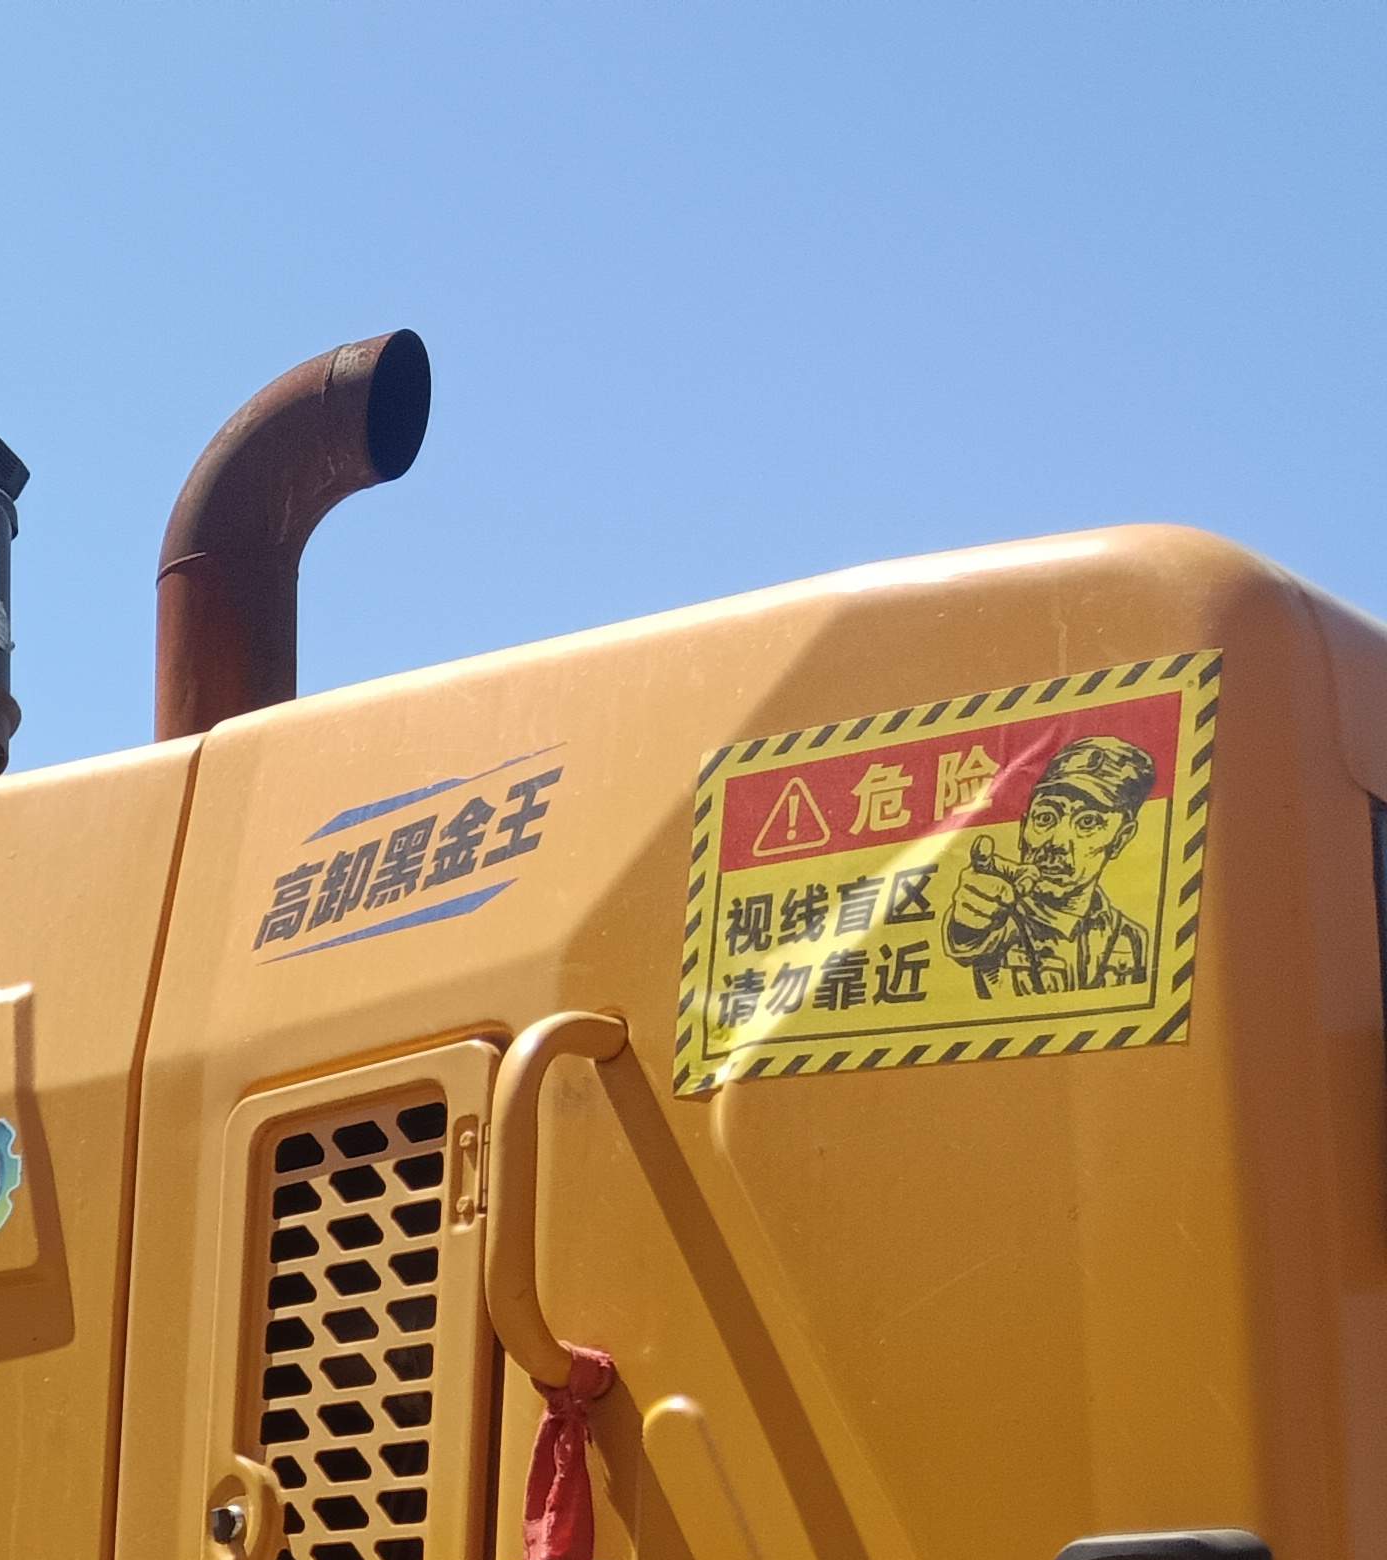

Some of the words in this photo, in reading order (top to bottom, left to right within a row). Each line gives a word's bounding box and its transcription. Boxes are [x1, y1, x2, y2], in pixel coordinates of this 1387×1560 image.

[849, 744, 1003, 836] 危险
[252, 766, 564, 951] 高卸黑金王
[724, 862, 938, 958] 视线盲区
[714, 939, 931, 1030] 请勿靠近
